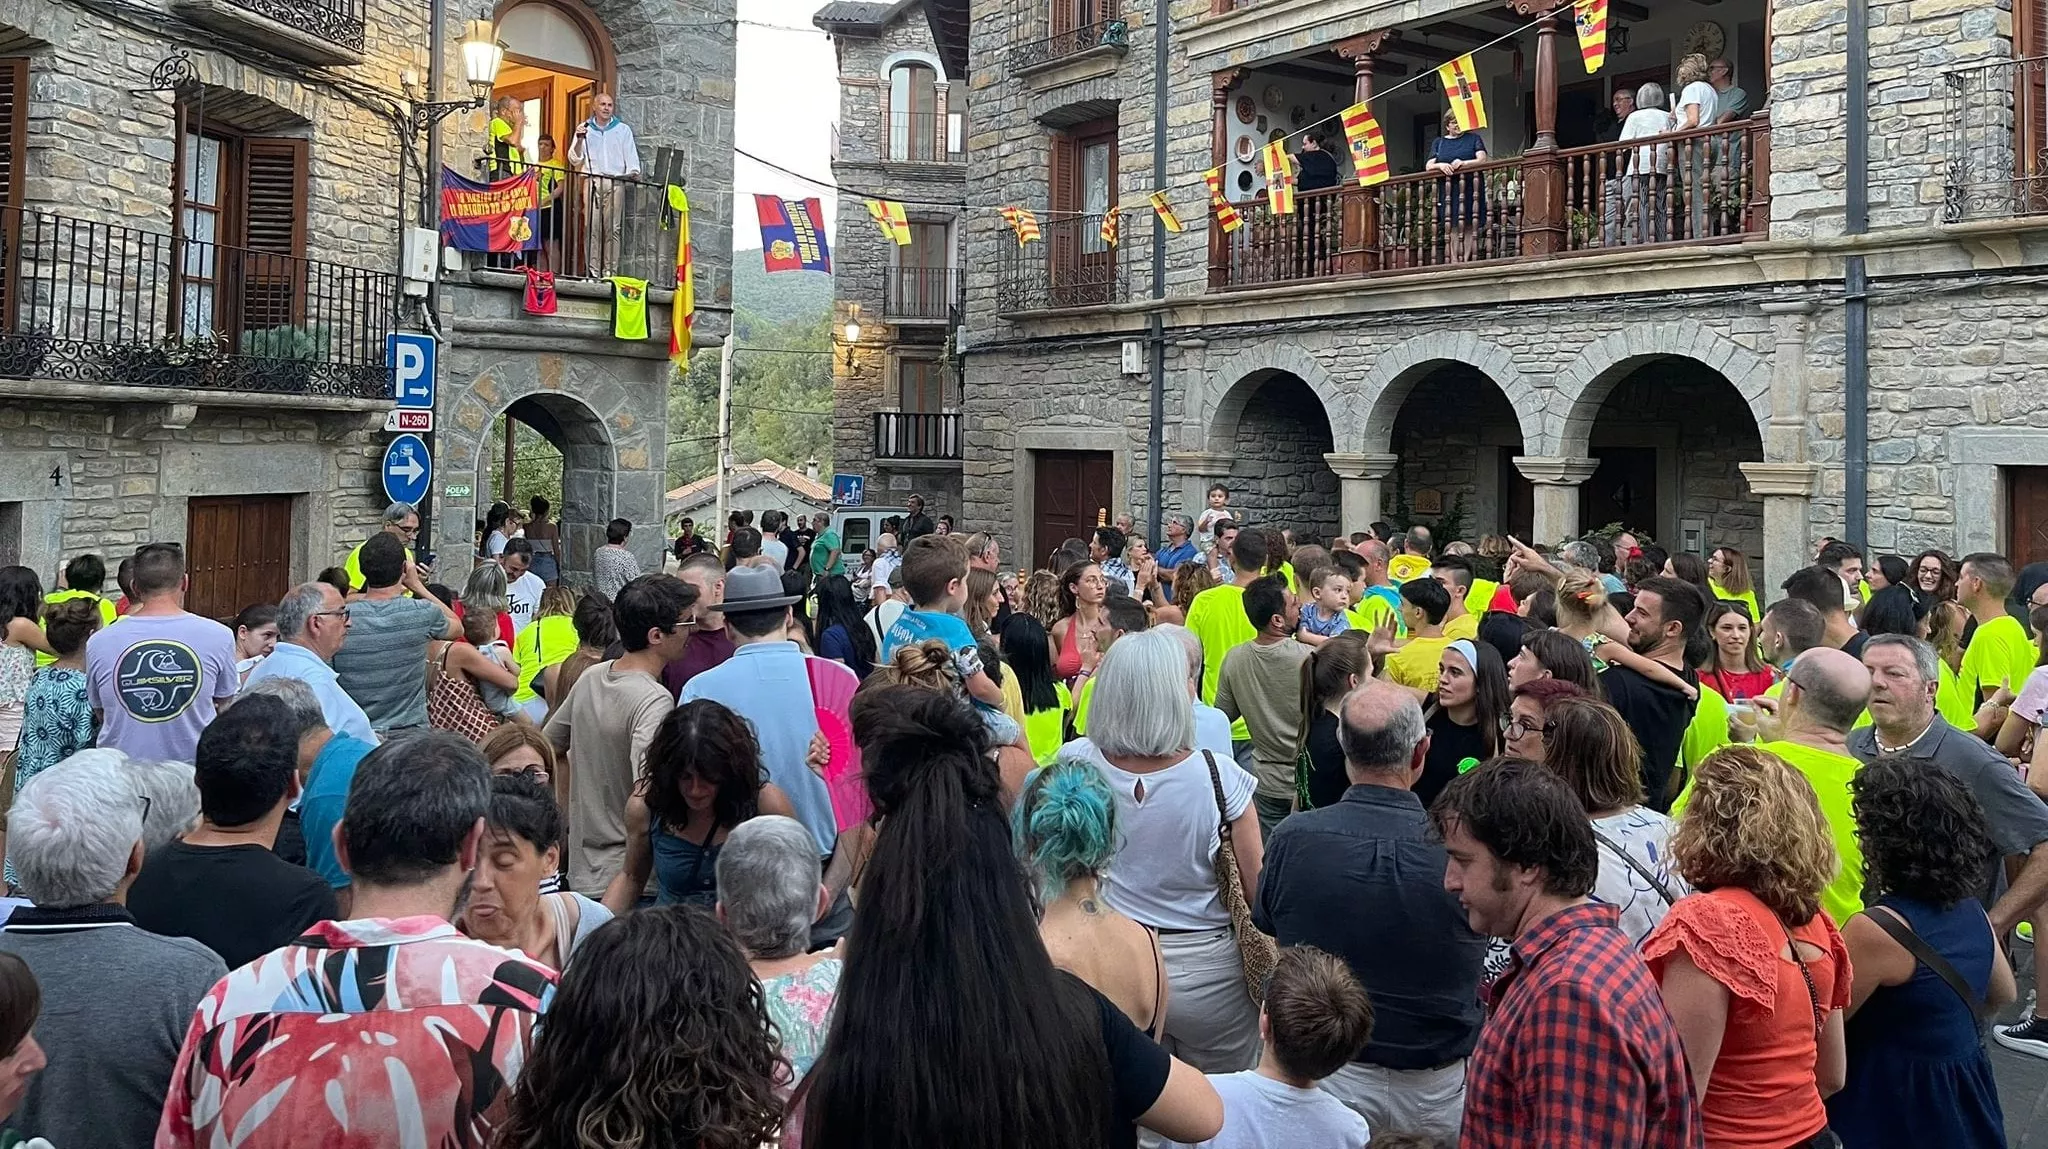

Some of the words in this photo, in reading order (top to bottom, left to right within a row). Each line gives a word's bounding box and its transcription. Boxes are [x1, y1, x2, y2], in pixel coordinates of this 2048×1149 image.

[395, 342, 425, 398] P
[388, 415, 396, 426] A
[401, 414, 428, 426] N-260
[49, 465, 63, 487] 4
[121, 674, 194, 687] QUIKSILVER
